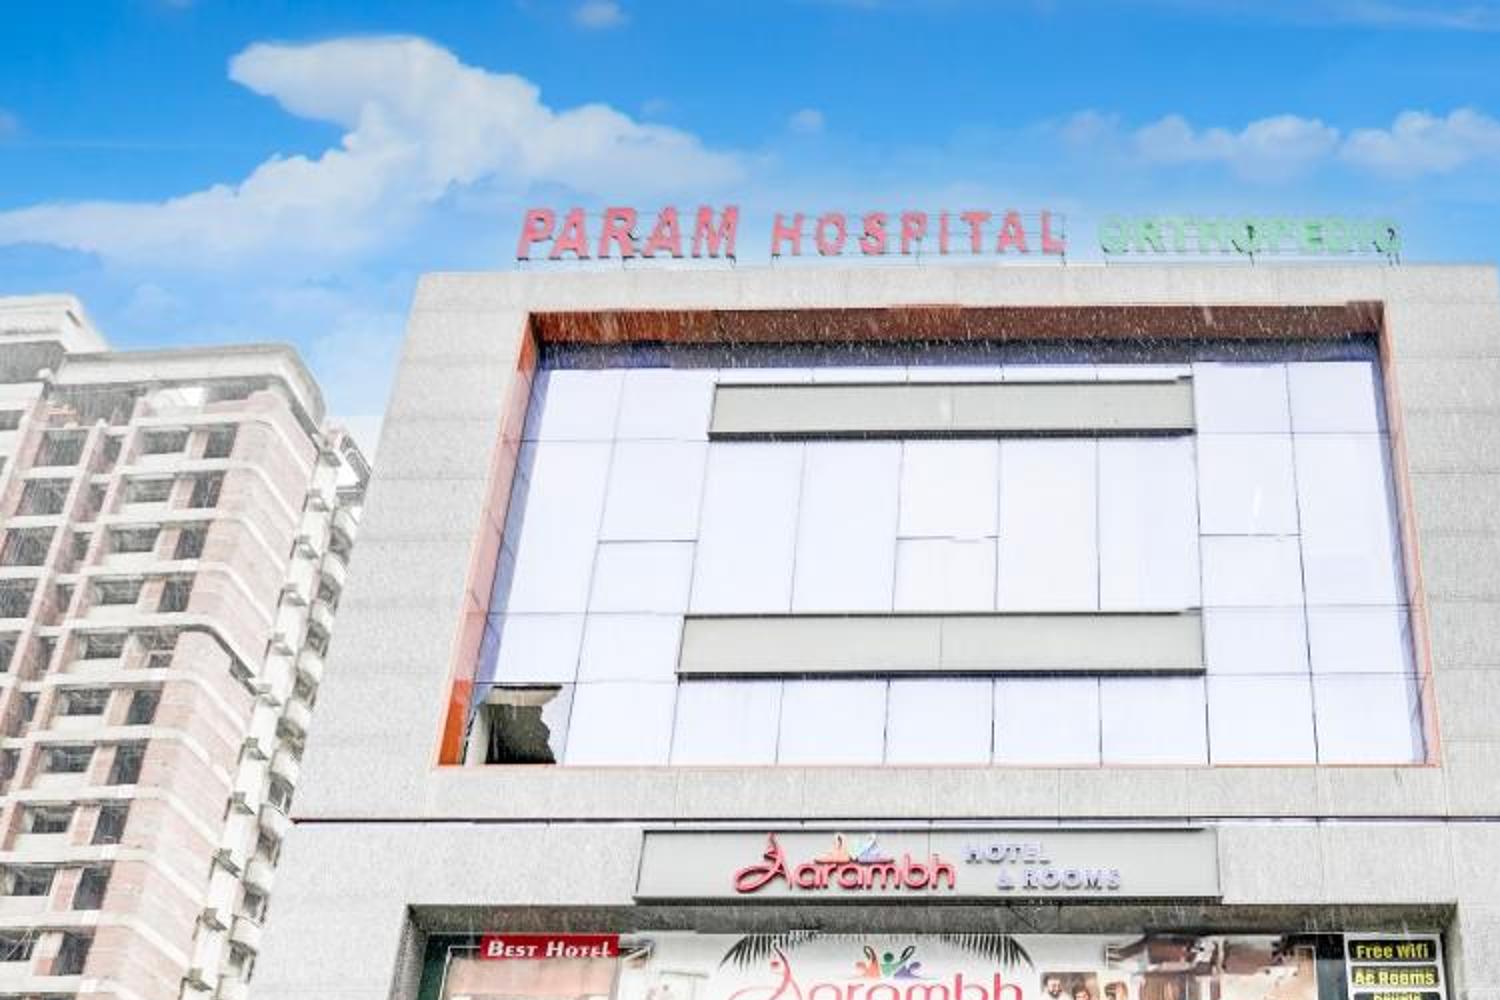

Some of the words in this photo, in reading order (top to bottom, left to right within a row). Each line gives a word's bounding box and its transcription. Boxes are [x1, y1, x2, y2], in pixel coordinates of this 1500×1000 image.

[517, 205, 739, 260] PARAM
[771, 209, 1067, 257] HOSPITAL
[735, 833, 956, 893] Aarambh
[965, 841, 1050, 865] HOTEL
[1022, 868, 1121, 891] ROOMS
[1356, 944, 1393, 959] Free
[1397, 943, 1429, 959] Wifi
[1378, 970, 1435, 985] Rooms
